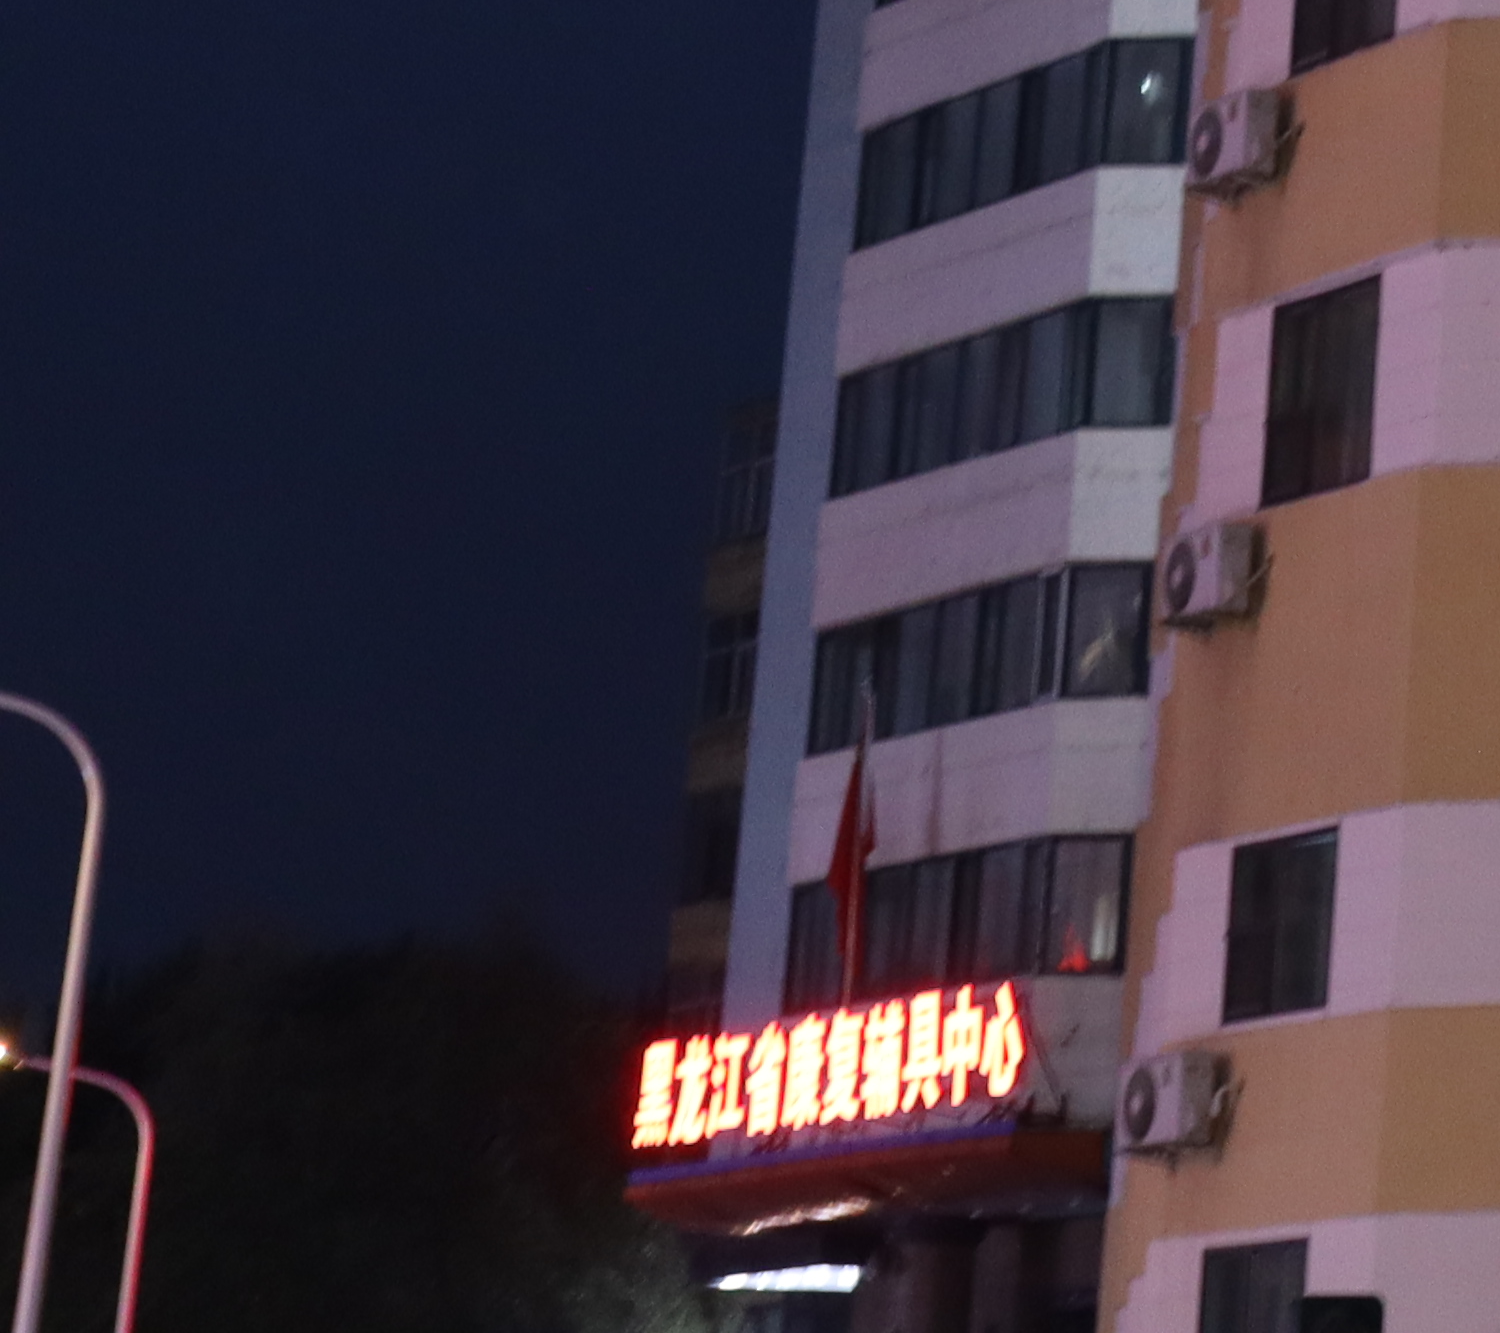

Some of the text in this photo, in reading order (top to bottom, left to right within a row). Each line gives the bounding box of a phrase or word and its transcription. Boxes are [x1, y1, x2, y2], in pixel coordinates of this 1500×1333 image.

[630, 979, 1027, 1150] 黑龙江省康复辅具中心
